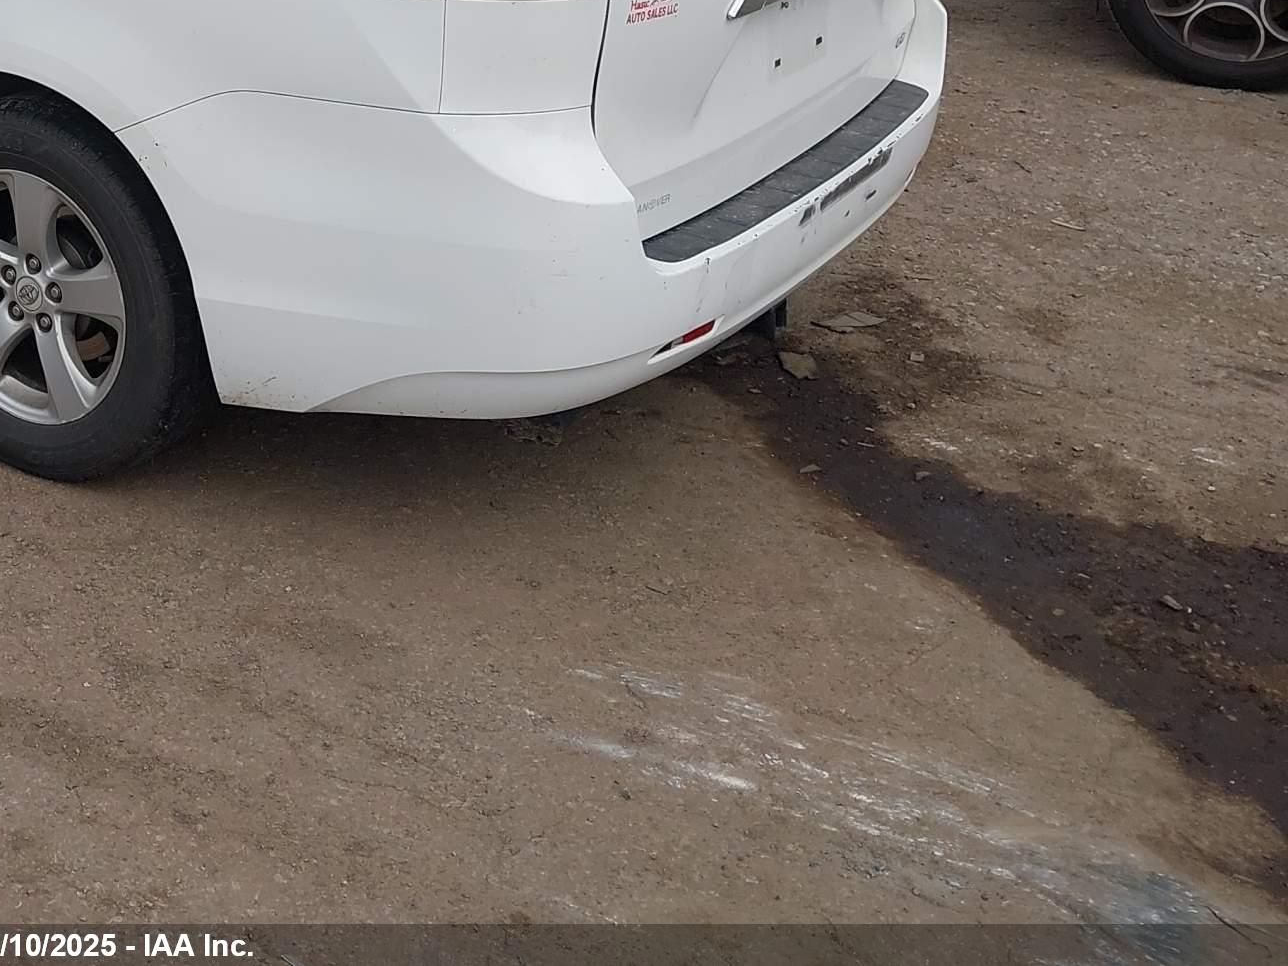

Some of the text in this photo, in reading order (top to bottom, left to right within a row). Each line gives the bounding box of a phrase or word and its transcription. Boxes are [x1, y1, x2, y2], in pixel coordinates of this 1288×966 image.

[626, 3, 679, 25] AUTO SALES LLC
